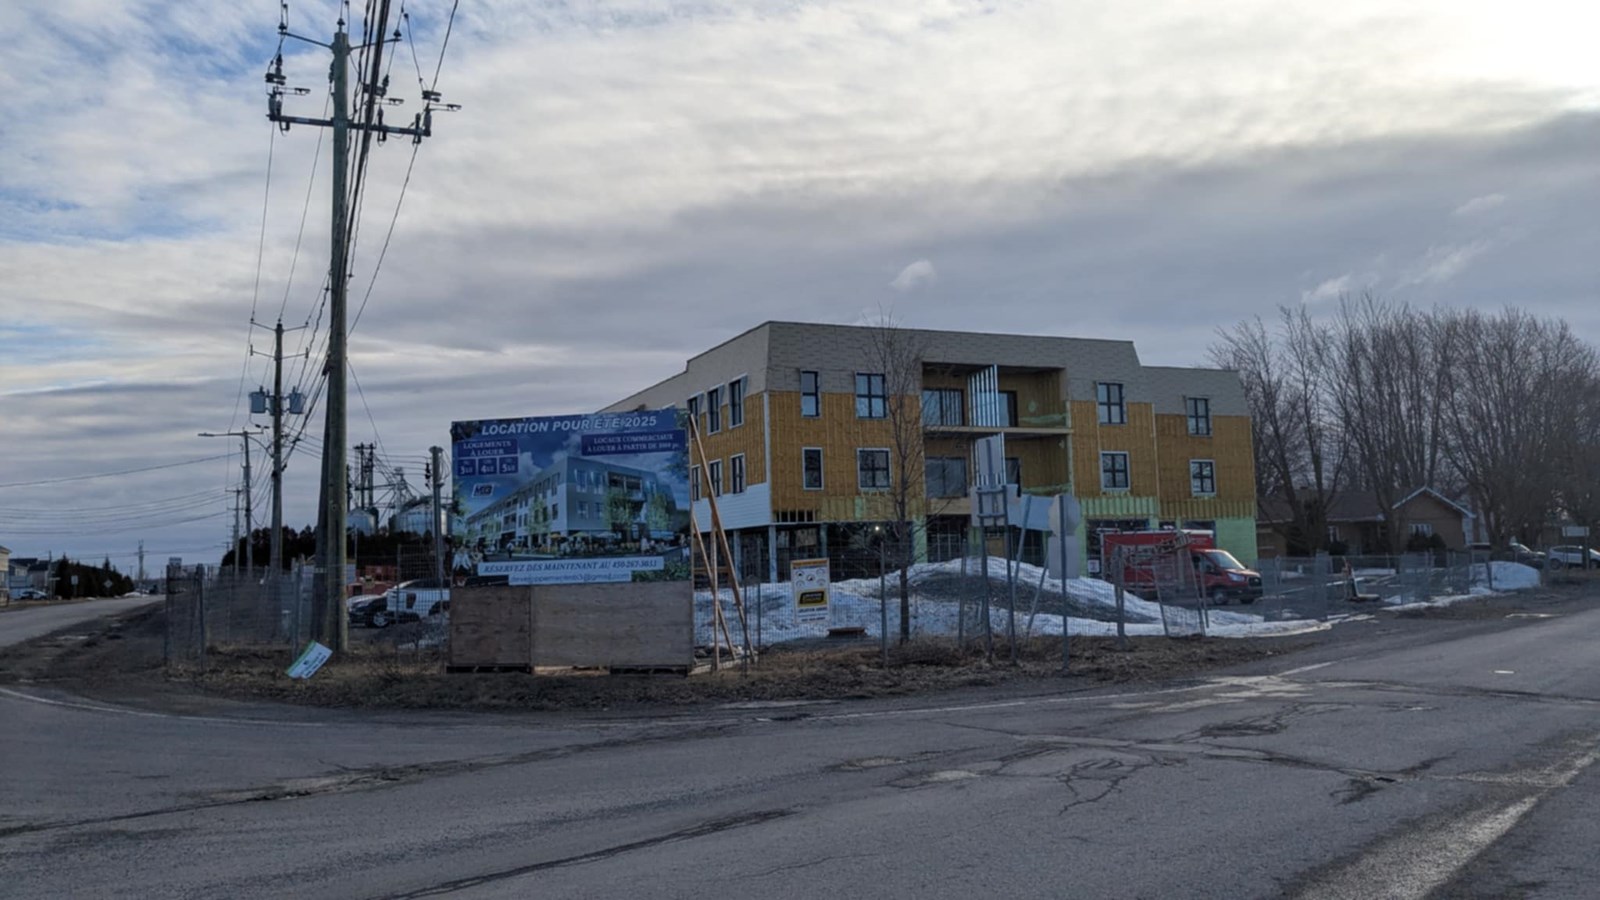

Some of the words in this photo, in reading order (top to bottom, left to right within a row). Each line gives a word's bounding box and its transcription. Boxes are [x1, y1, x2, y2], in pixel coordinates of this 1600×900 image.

[482, 421, 549, 435] LOCATION
[552, 418, 590, 431] POUR
[624, 416, 657, 427] 2025
[463, 440, 512, 449] LOGEMENTS
